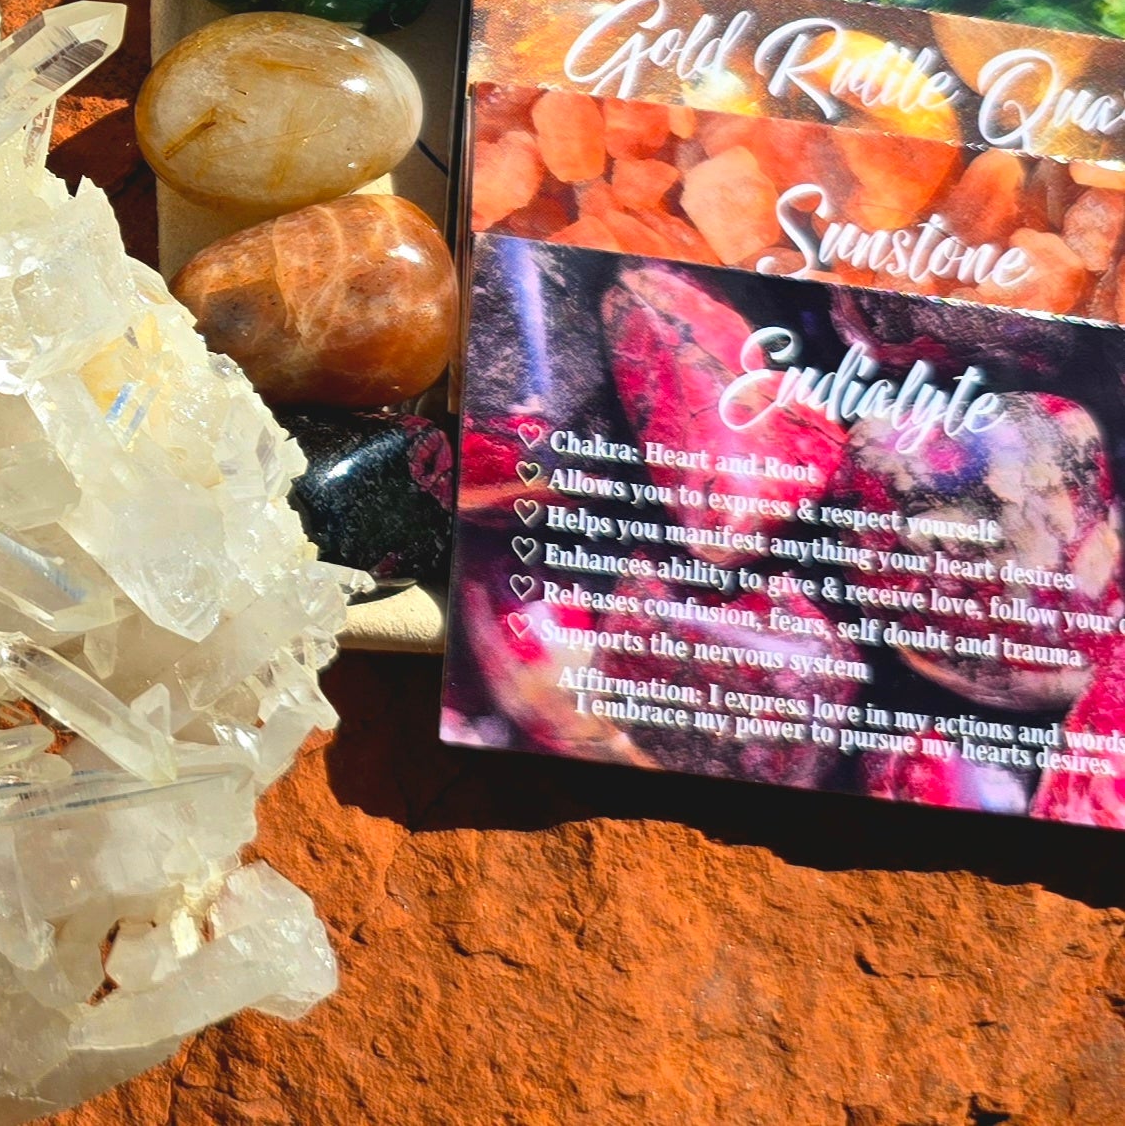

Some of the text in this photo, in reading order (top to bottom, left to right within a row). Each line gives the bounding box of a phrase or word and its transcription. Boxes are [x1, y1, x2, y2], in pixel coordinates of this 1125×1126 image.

[754, 17, 960, 120] Rutile
[977, 48, 1125, 155] Qua
[756, 183, 1032, 289] Sunstone
[720, 326, 1005, 454] Eudialyte
[550, 431, 816, 483] Chakra: Heart and Root
[546, 505, 1076, 590] Helps you manifest anything your heart desires
[548, 468, 998, 542] Allows you to express & respect yourself
[543, 580, 1083, 667] Releases confusion, fears, self doubt and trauma
[545, 543, 652, 576] Enhances
[657, 557, 731, 590] ability
[739, 568, 762, 589] to
[768, 571, 815, 596] give
[821, 577, 840, 599] &
[845, 581, 925, 609] receive
[931, 588, 983, 618] love,
[988, 593, 1059, 624] follow
[1062, 611, 1115, 633] your
[539, 619, 869, 679] Supports the nervous system
[557, 666, 702, 704] Affirmation:
[708, 683, 720, 706] I
[725, 690, 806, 717] express
[813, 694, 861, 716] love
[866, 703, 890, 725] in
[894, 709, 929, 732] my
[935, 715, 1012, 741] actions
[1018, 724, 1058, 745] and
[575, 692, 1117, 776] I embrace my power to pursue my hearts desires.
